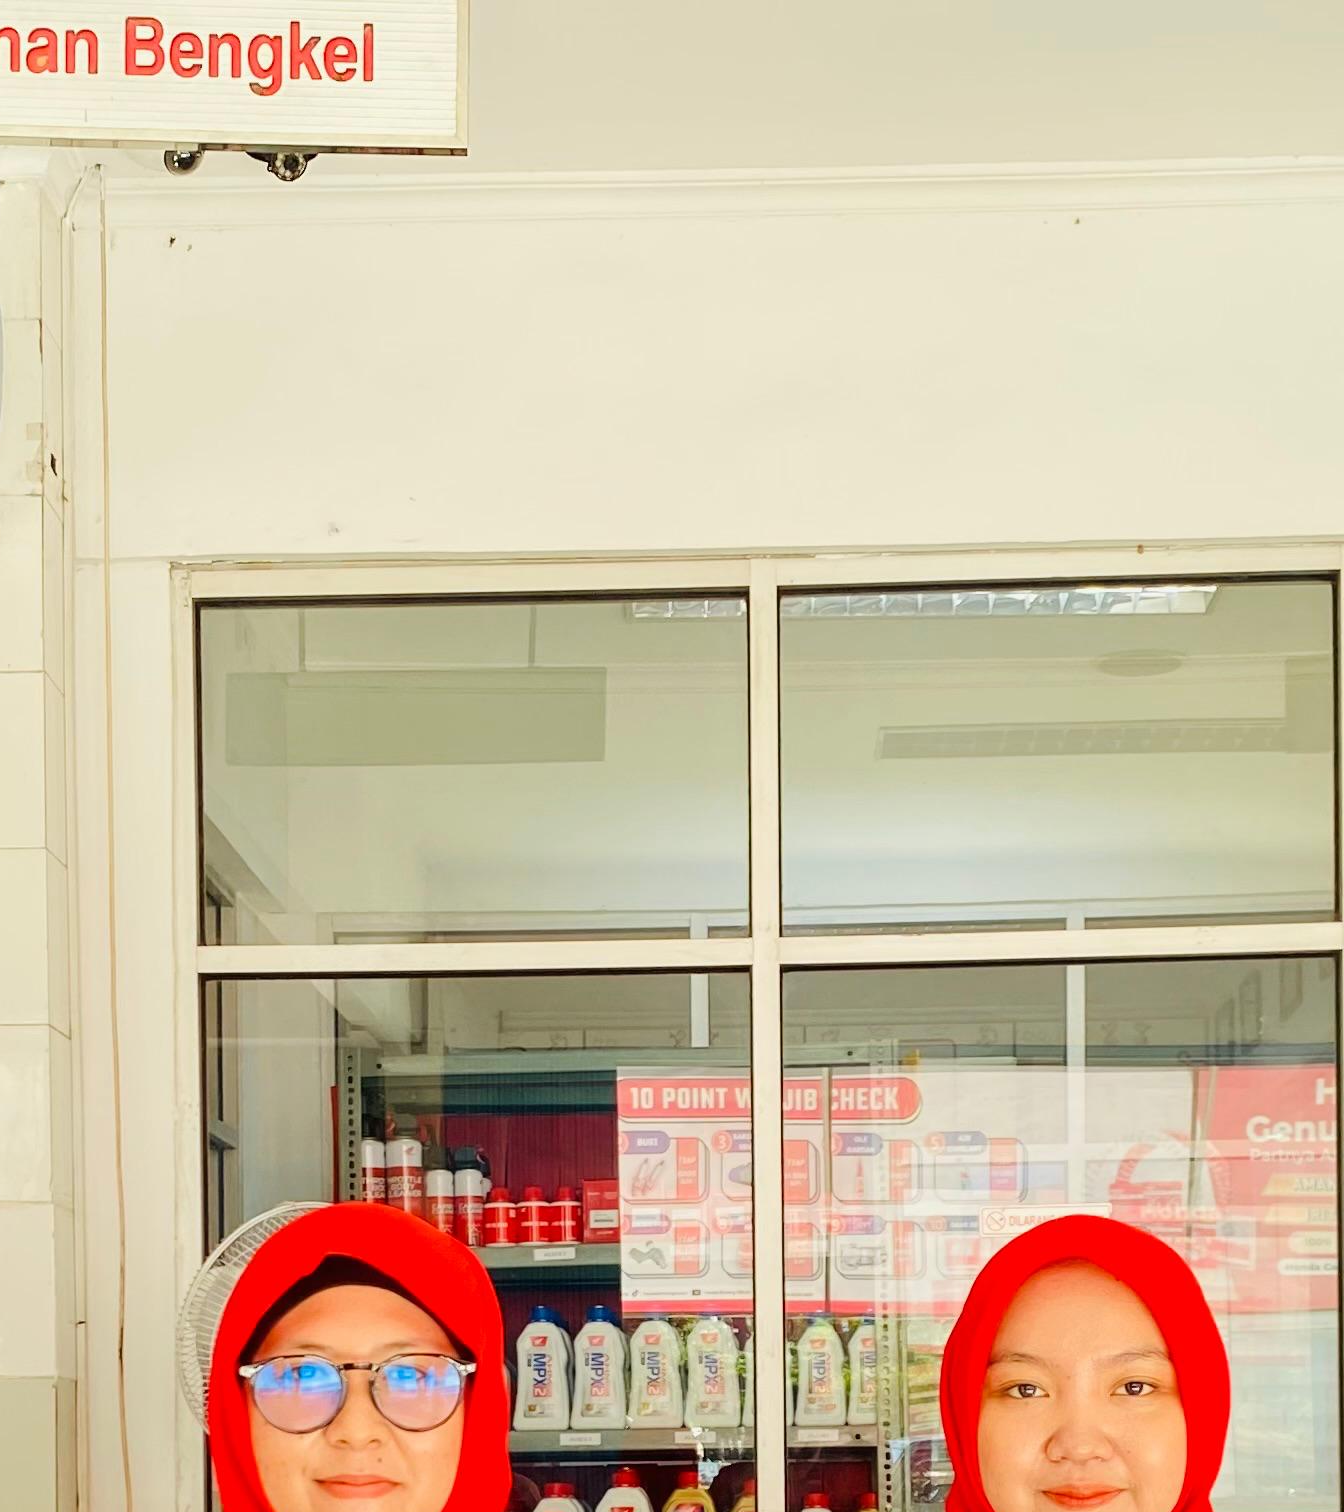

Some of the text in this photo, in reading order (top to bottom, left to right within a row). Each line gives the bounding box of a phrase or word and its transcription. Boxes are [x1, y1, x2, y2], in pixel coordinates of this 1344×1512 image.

[125, 17, 374, 96] Bengkel
[630, 1086, 654, 1109] 10
[662, 1086, 729, 1110] POINT
[831, 1086, 899, 1111] CHECK
